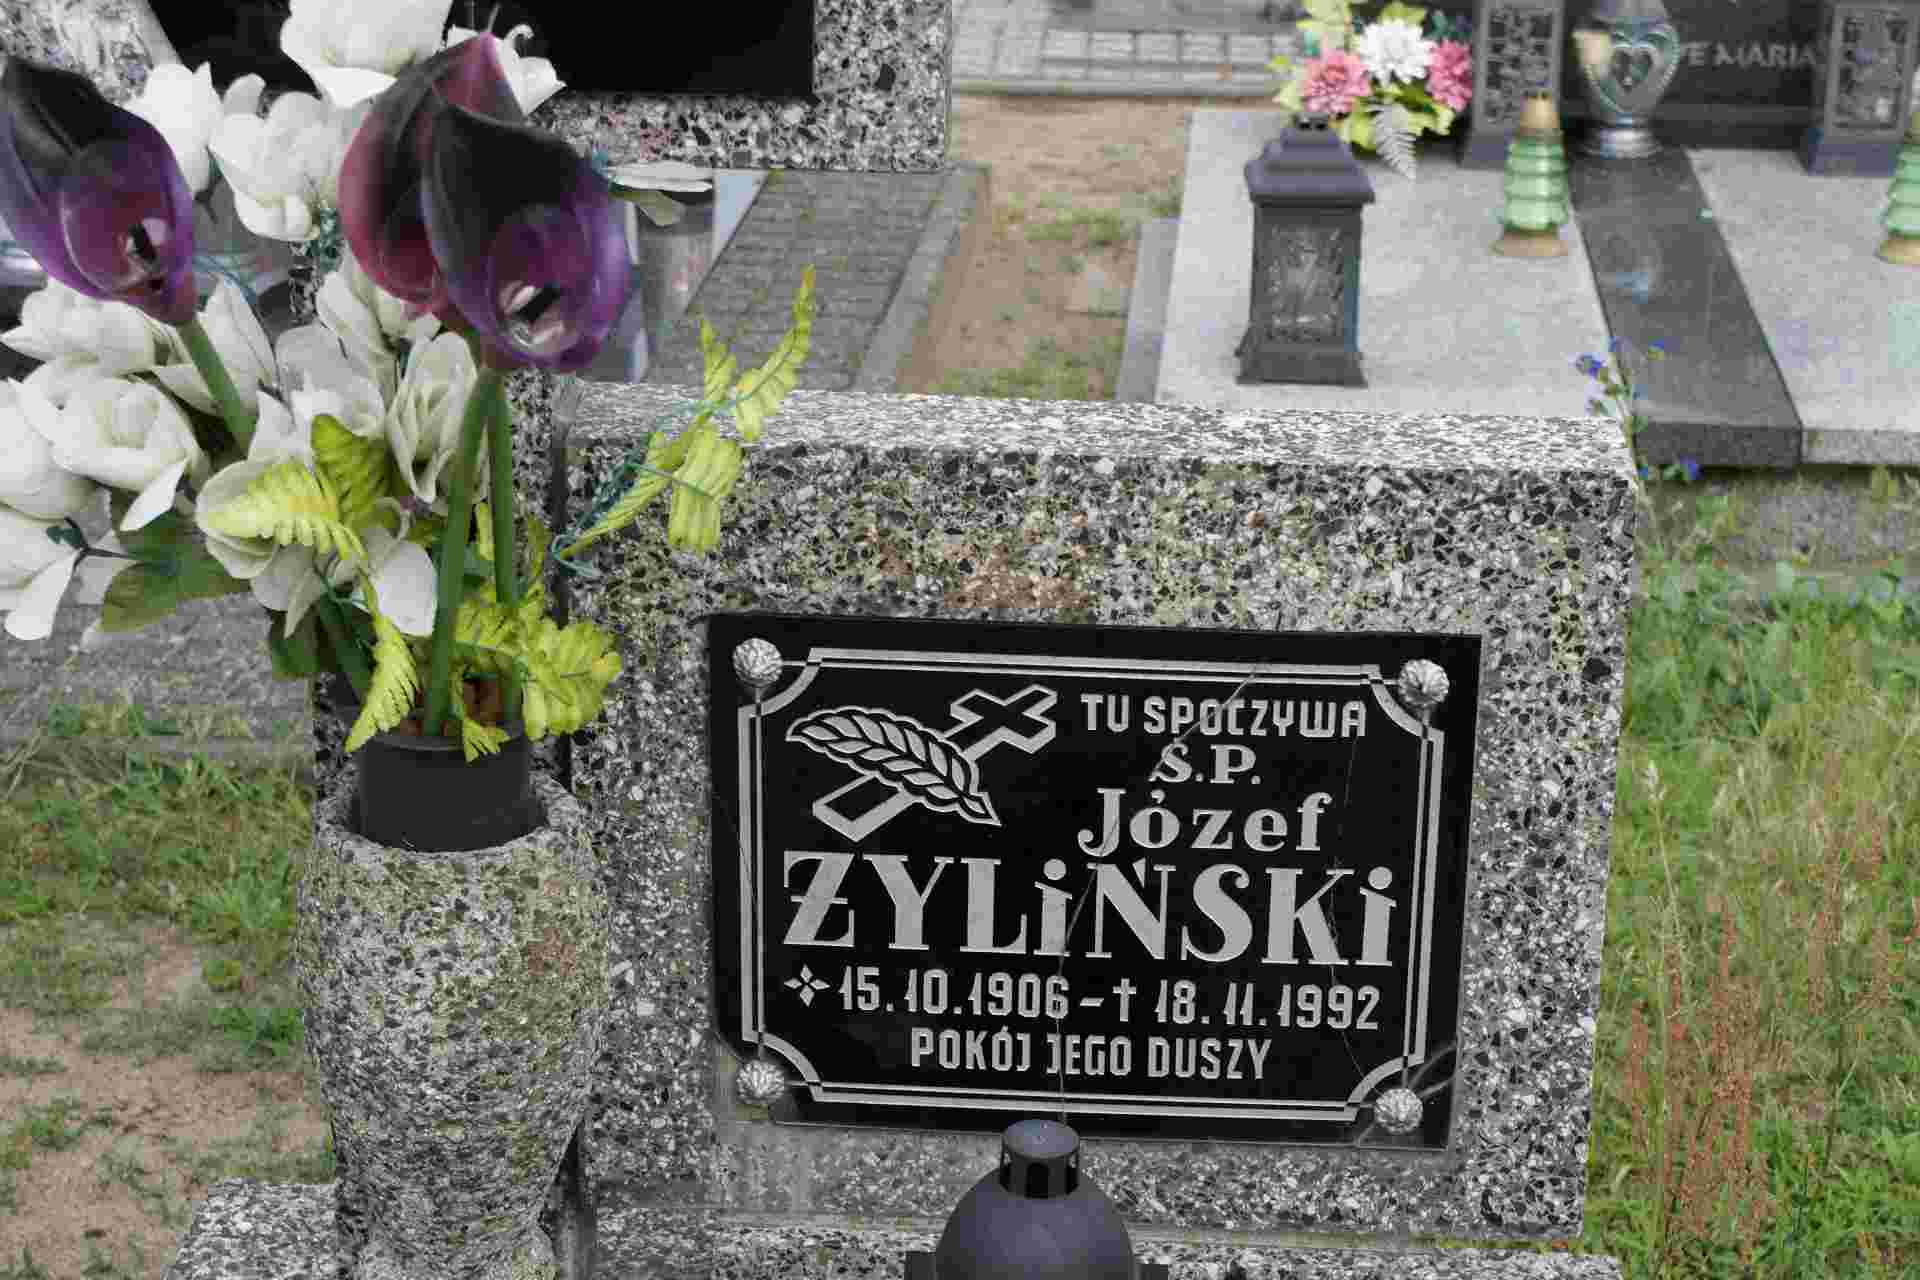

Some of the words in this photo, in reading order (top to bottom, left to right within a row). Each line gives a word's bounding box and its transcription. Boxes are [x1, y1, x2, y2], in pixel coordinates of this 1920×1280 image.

[1713, 41, 1818, 67] MARIA
[1081, 694, 1130, 733] TU
[1144, 695, 1368, 738] SPOCZYWA
[1077, 787, 1333, 857] Józef
[911, 1026, 1031, 1074] POKÓJ
[1047, 1034, 1133, 1076] JEGO
[1148, 1036, 1273, 1081] DUSZY
